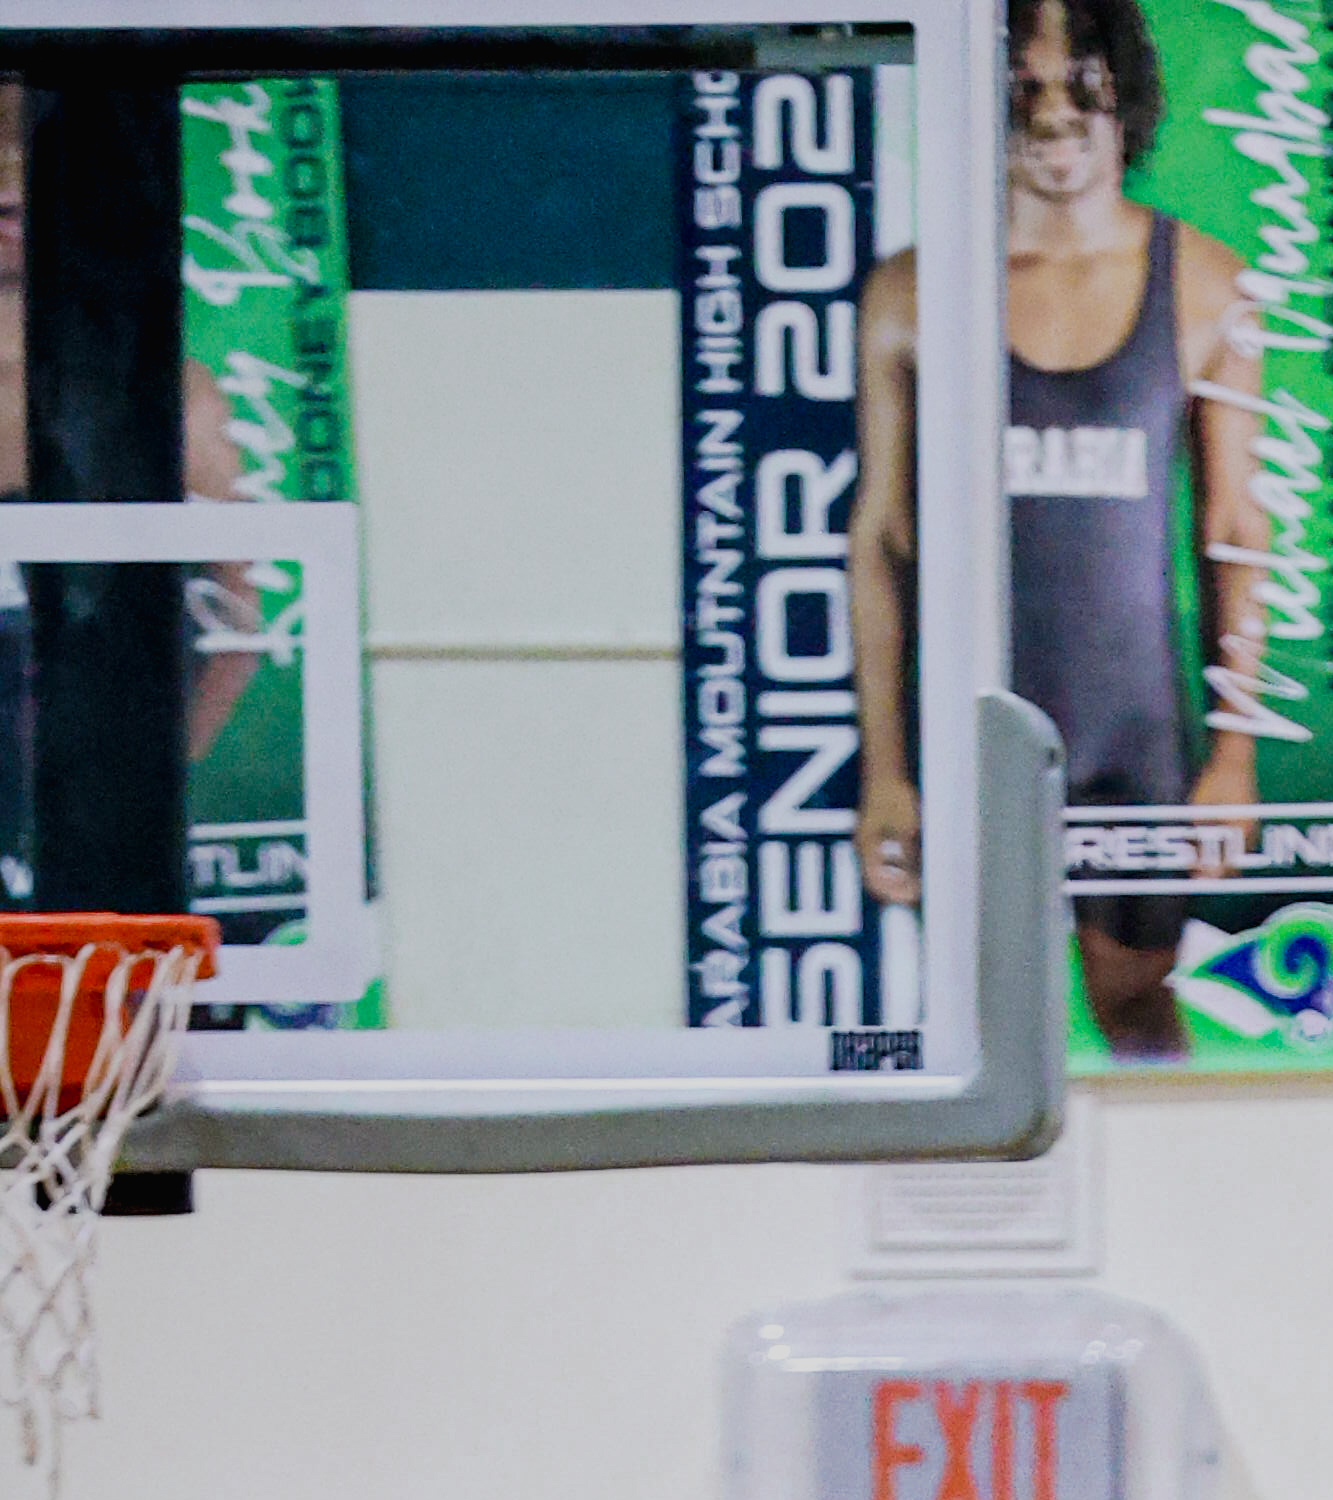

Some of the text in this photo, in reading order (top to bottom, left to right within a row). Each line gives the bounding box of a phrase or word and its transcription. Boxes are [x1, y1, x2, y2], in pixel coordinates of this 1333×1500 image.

[694, 246, 744, 394] HIGH
[694, 409, 748, 778] MOUTNTAIN
[754, 448, 864, 1028] SENIOR
[690, 792, 750, 1028] ARABIA
